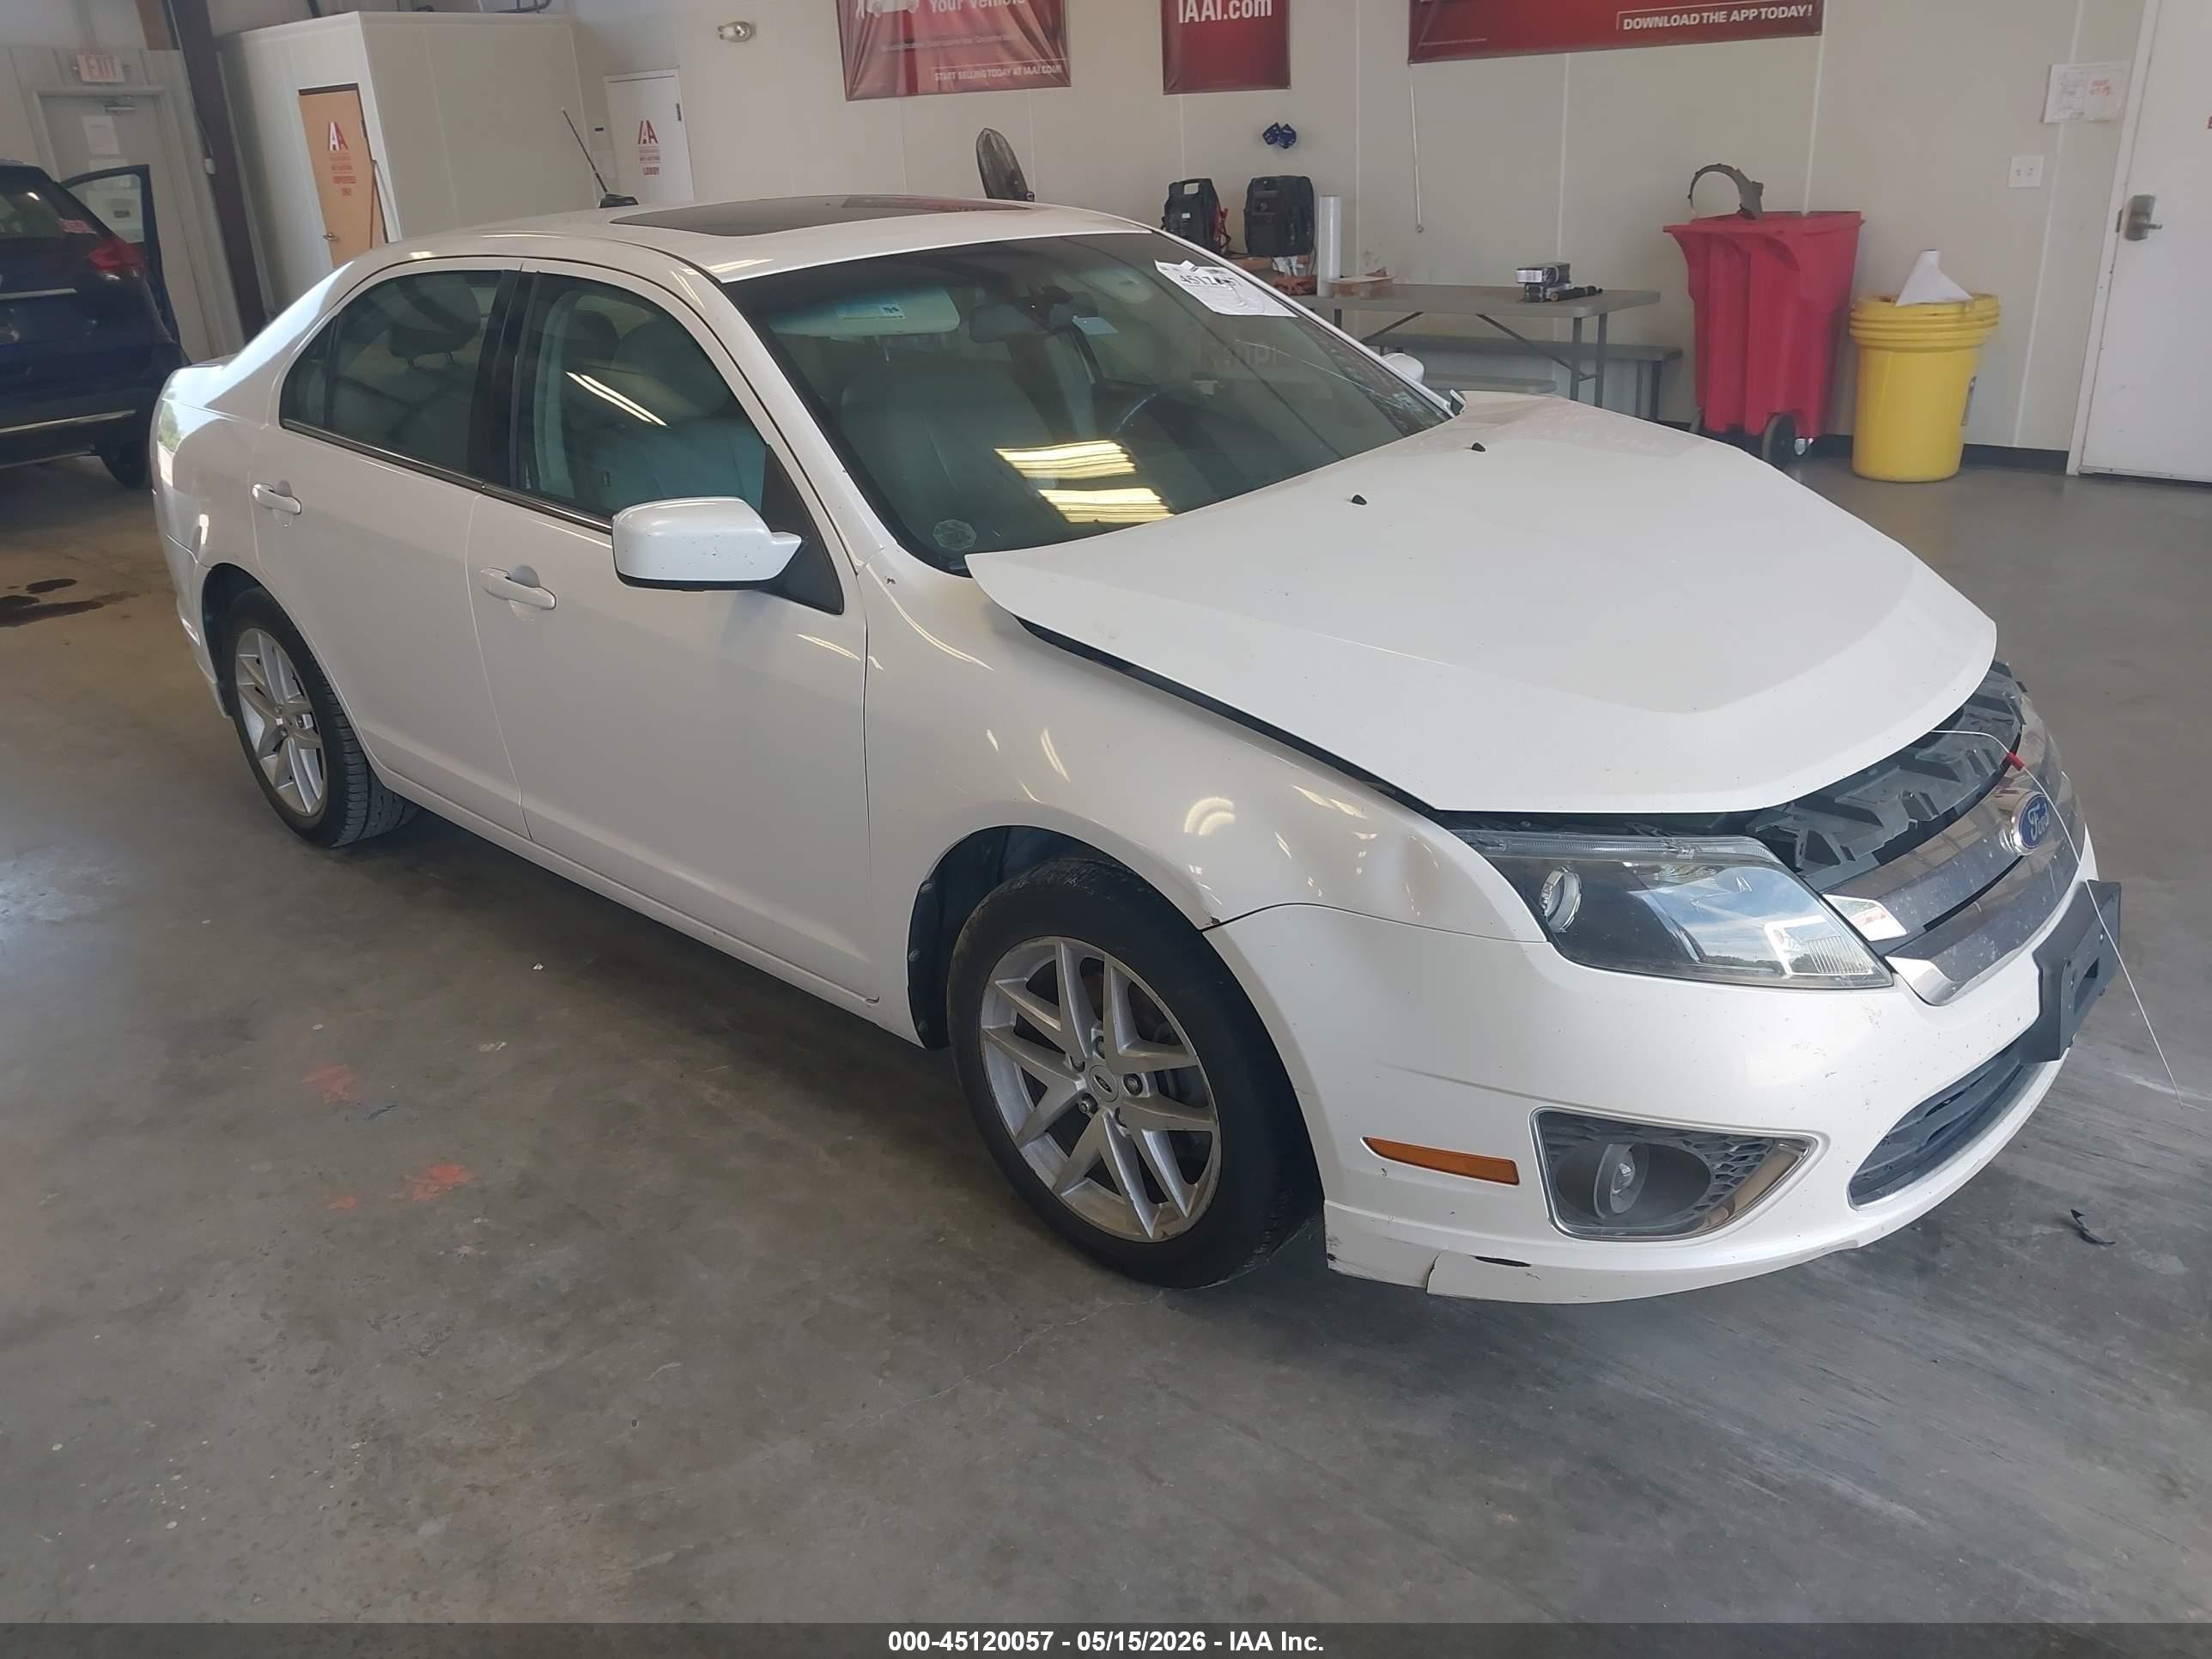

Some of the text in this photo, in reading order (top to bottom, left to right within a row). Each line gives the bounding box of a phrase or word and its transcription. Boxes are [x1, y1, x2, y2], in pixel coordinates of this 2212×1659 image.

[1178, 0, 1272, 23] IAAI.com
[1623, 4, 1814, 30] DOWNLOAD THE APP TODAY!
[85, 56, 118, 76] EXIT
[2027, 803, 2050, 842] Ford
